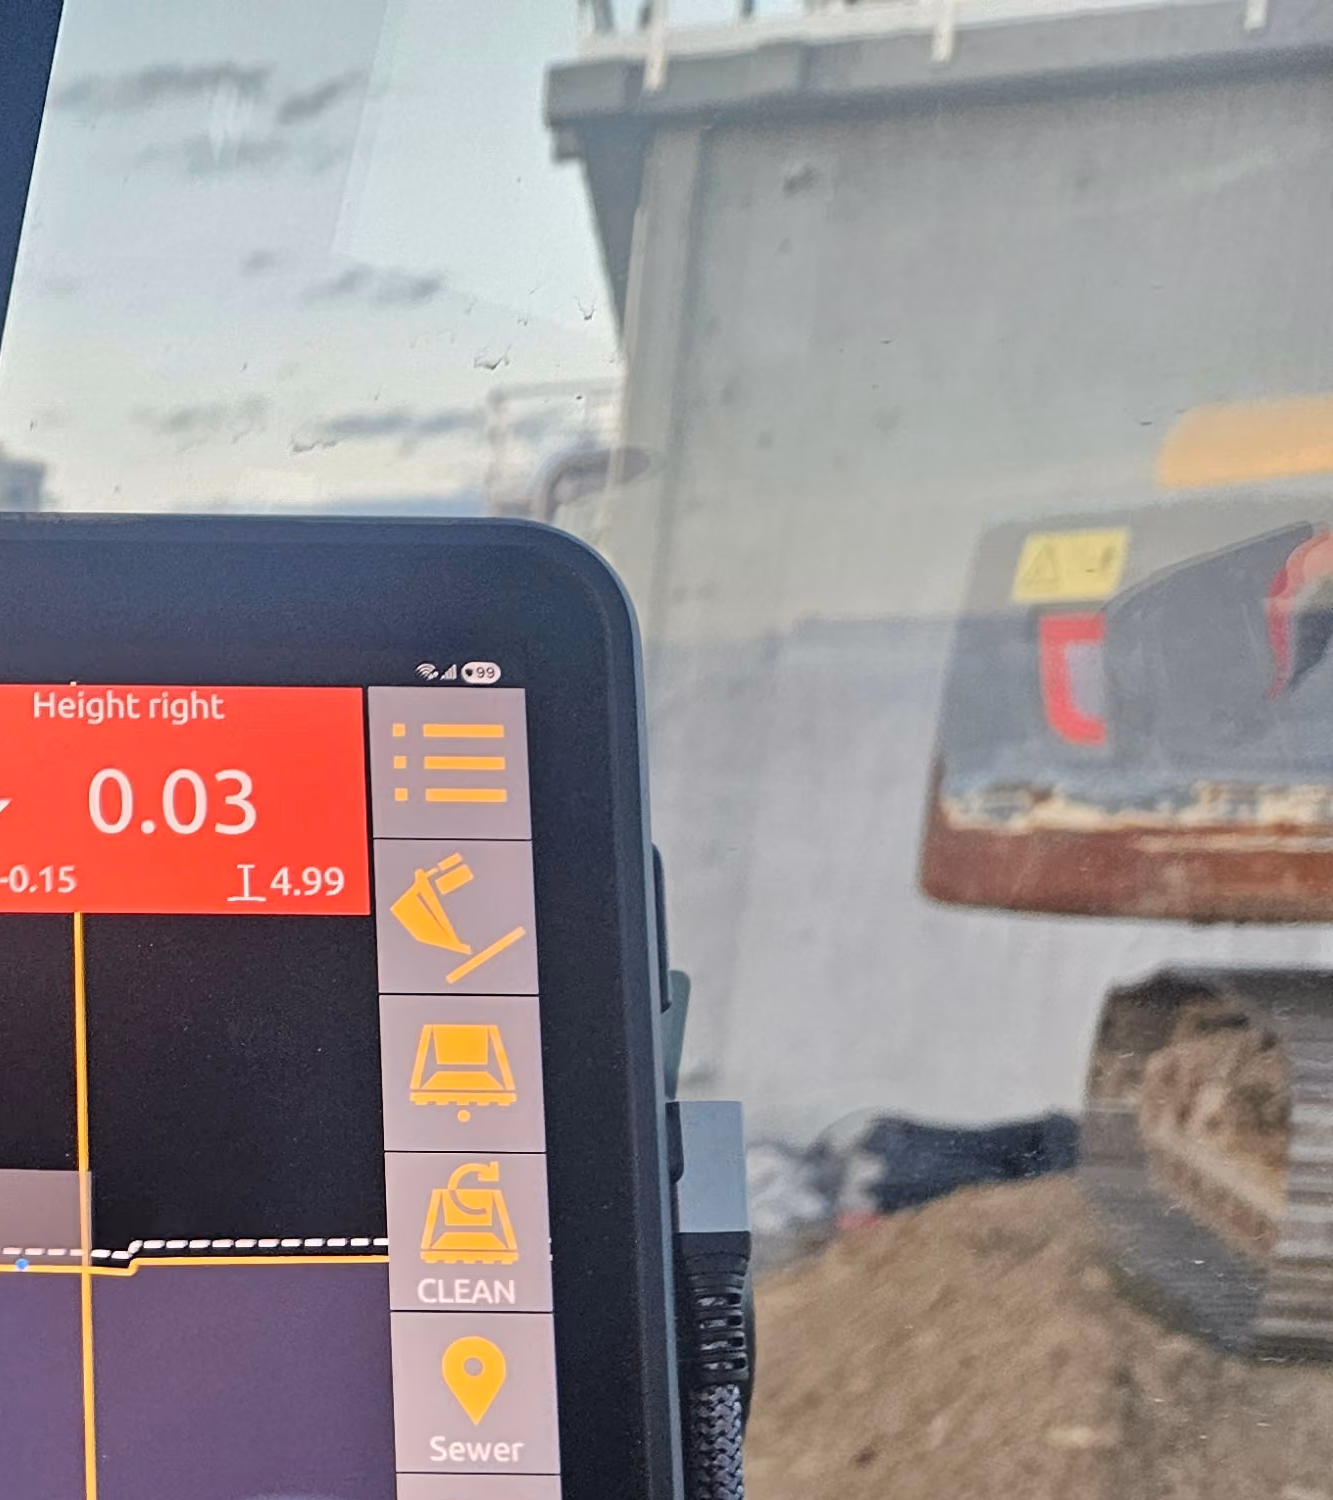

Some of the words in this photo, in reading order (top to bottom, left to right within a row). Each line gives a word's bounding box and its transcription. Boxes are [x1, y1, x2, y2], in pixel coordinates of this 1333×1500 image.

[476, 666, 495, 679] 99
[32, 689, 140, 725] Height
[148, 691, 226, 726] right
[87, 767, 258, 836] 0.03
[269, 866, 346, 897] 4.99
[417, 1277, 516, 1305] CLEAN
[429, 1435, 526, 1463] Sewer
